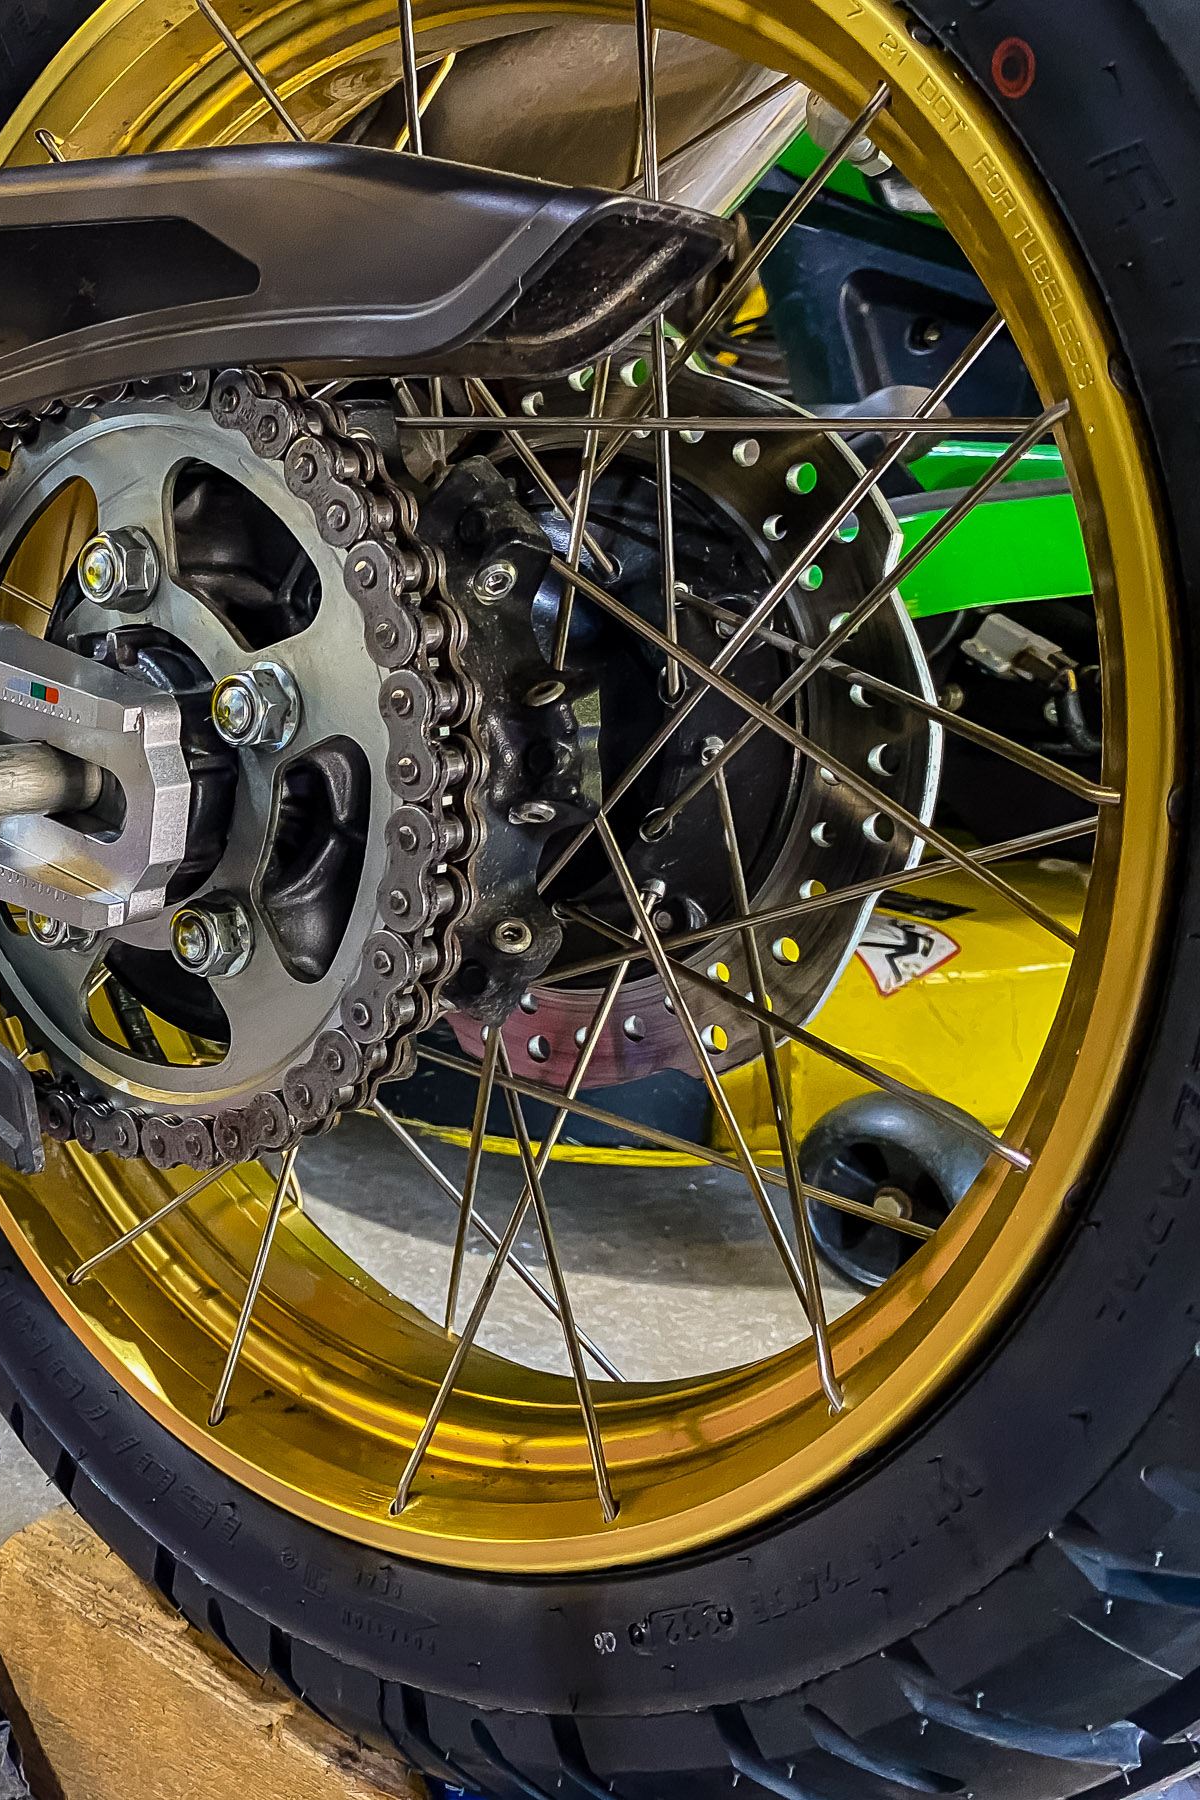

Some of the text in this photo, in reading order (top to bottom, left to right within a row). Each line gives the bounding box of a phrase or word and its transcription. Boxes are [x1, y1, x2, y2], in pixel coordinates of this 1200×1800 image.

[916, 76, 969, 135] DOT
[972, 153, 1018, 218] FOR
[1013, 225, 1095, 390] TUBELESS
